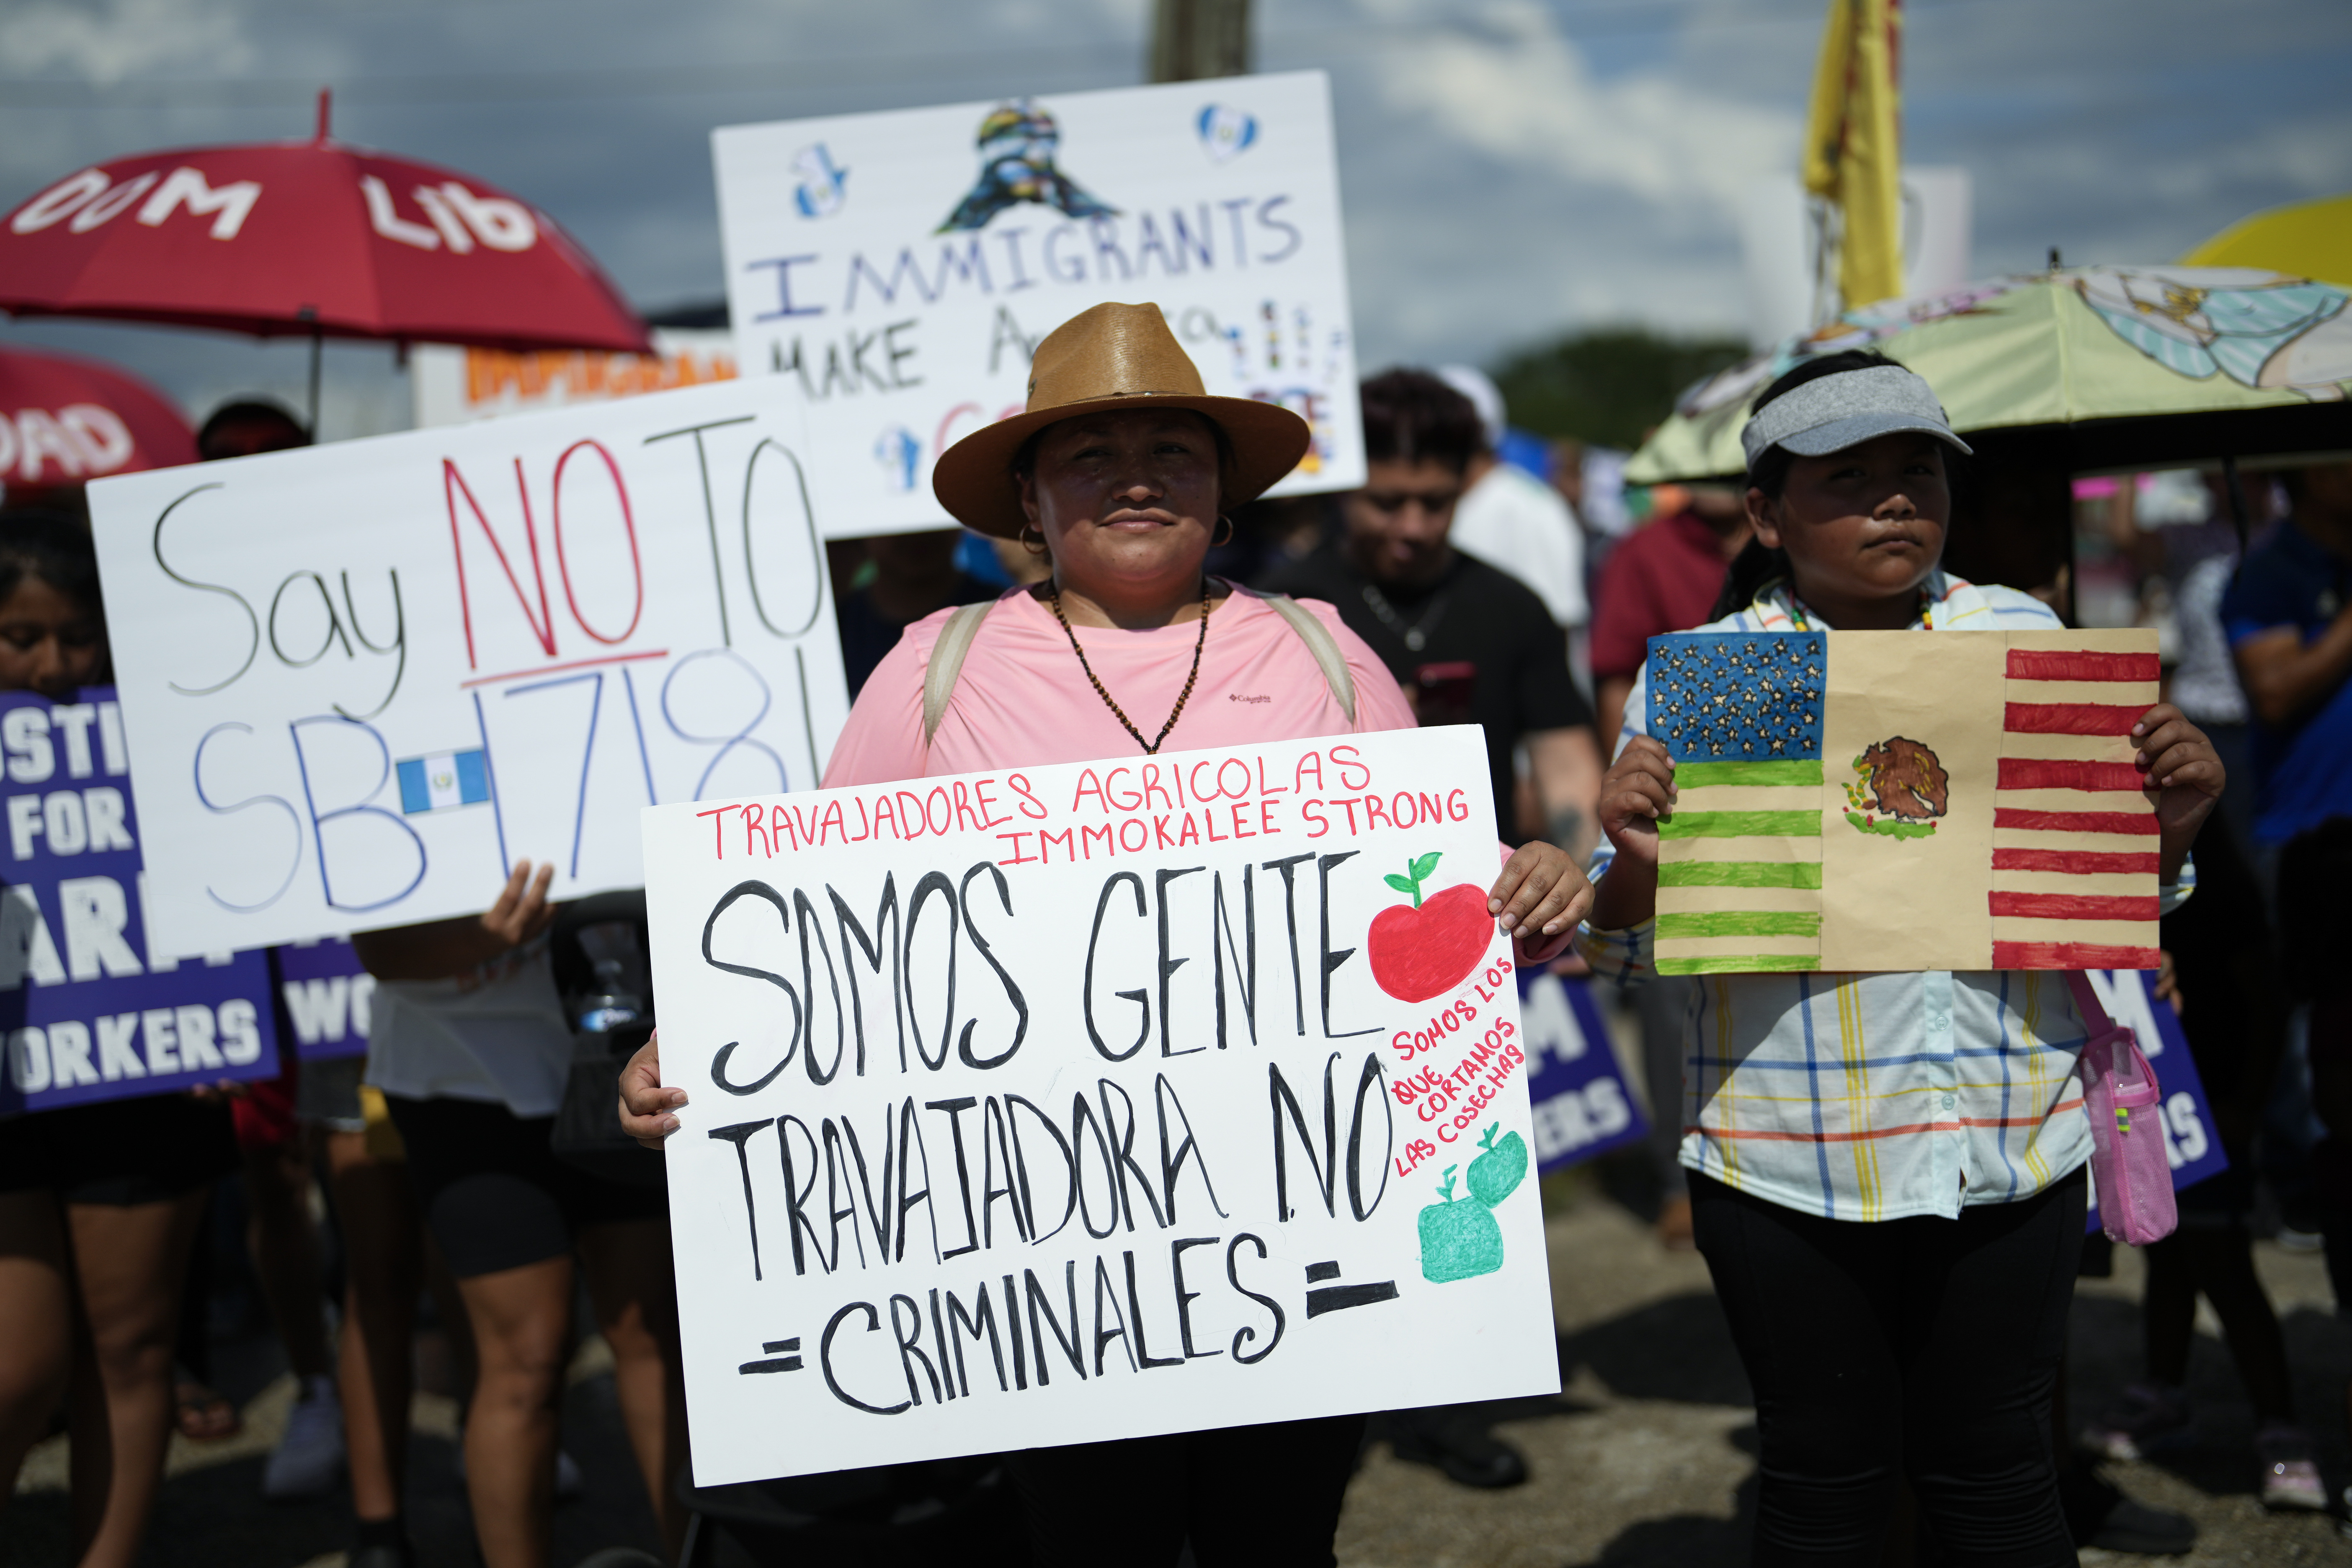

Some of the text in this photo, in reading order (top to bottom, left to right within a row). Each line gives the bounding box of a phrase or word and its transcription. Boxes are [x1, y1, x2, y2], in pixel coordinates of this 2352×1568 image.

[745, 195, 1302, 322] IMMIGRANTS
[770, 318, 926, 403] MAKE
[0, 401, 136, 482] AD
[154, 415, 823, 721] Say NO TO
[0, 699, 128, 785] STI
[6, 785, 136, 862] FOR
[696, 745, 1371, 860] TRAVAJADORES AGRICOLAS
[997, 788, 1469, 866] IMMOKALEE STRONG
[702, 861, 1029, 1096] SOMOS
[1083, 850, 1385, 1063] GENTE
[1392, 999, 1477, 1061] SOMOS
[1475, 957, 1513, 1003] LOS
[0, 998, 263, 1095] ORKERS
[1391, 1065, 1443, 1105] QUE
[1417, 1016, 1515, 1122] CORTAMOS
[1395, 1044, 1525, 1177] LAS COSECHAS
[708, 1052, 1393, 1282] TRAVAJADORA NO
[820, 1233, 1286, 1416] CRIMINALES
